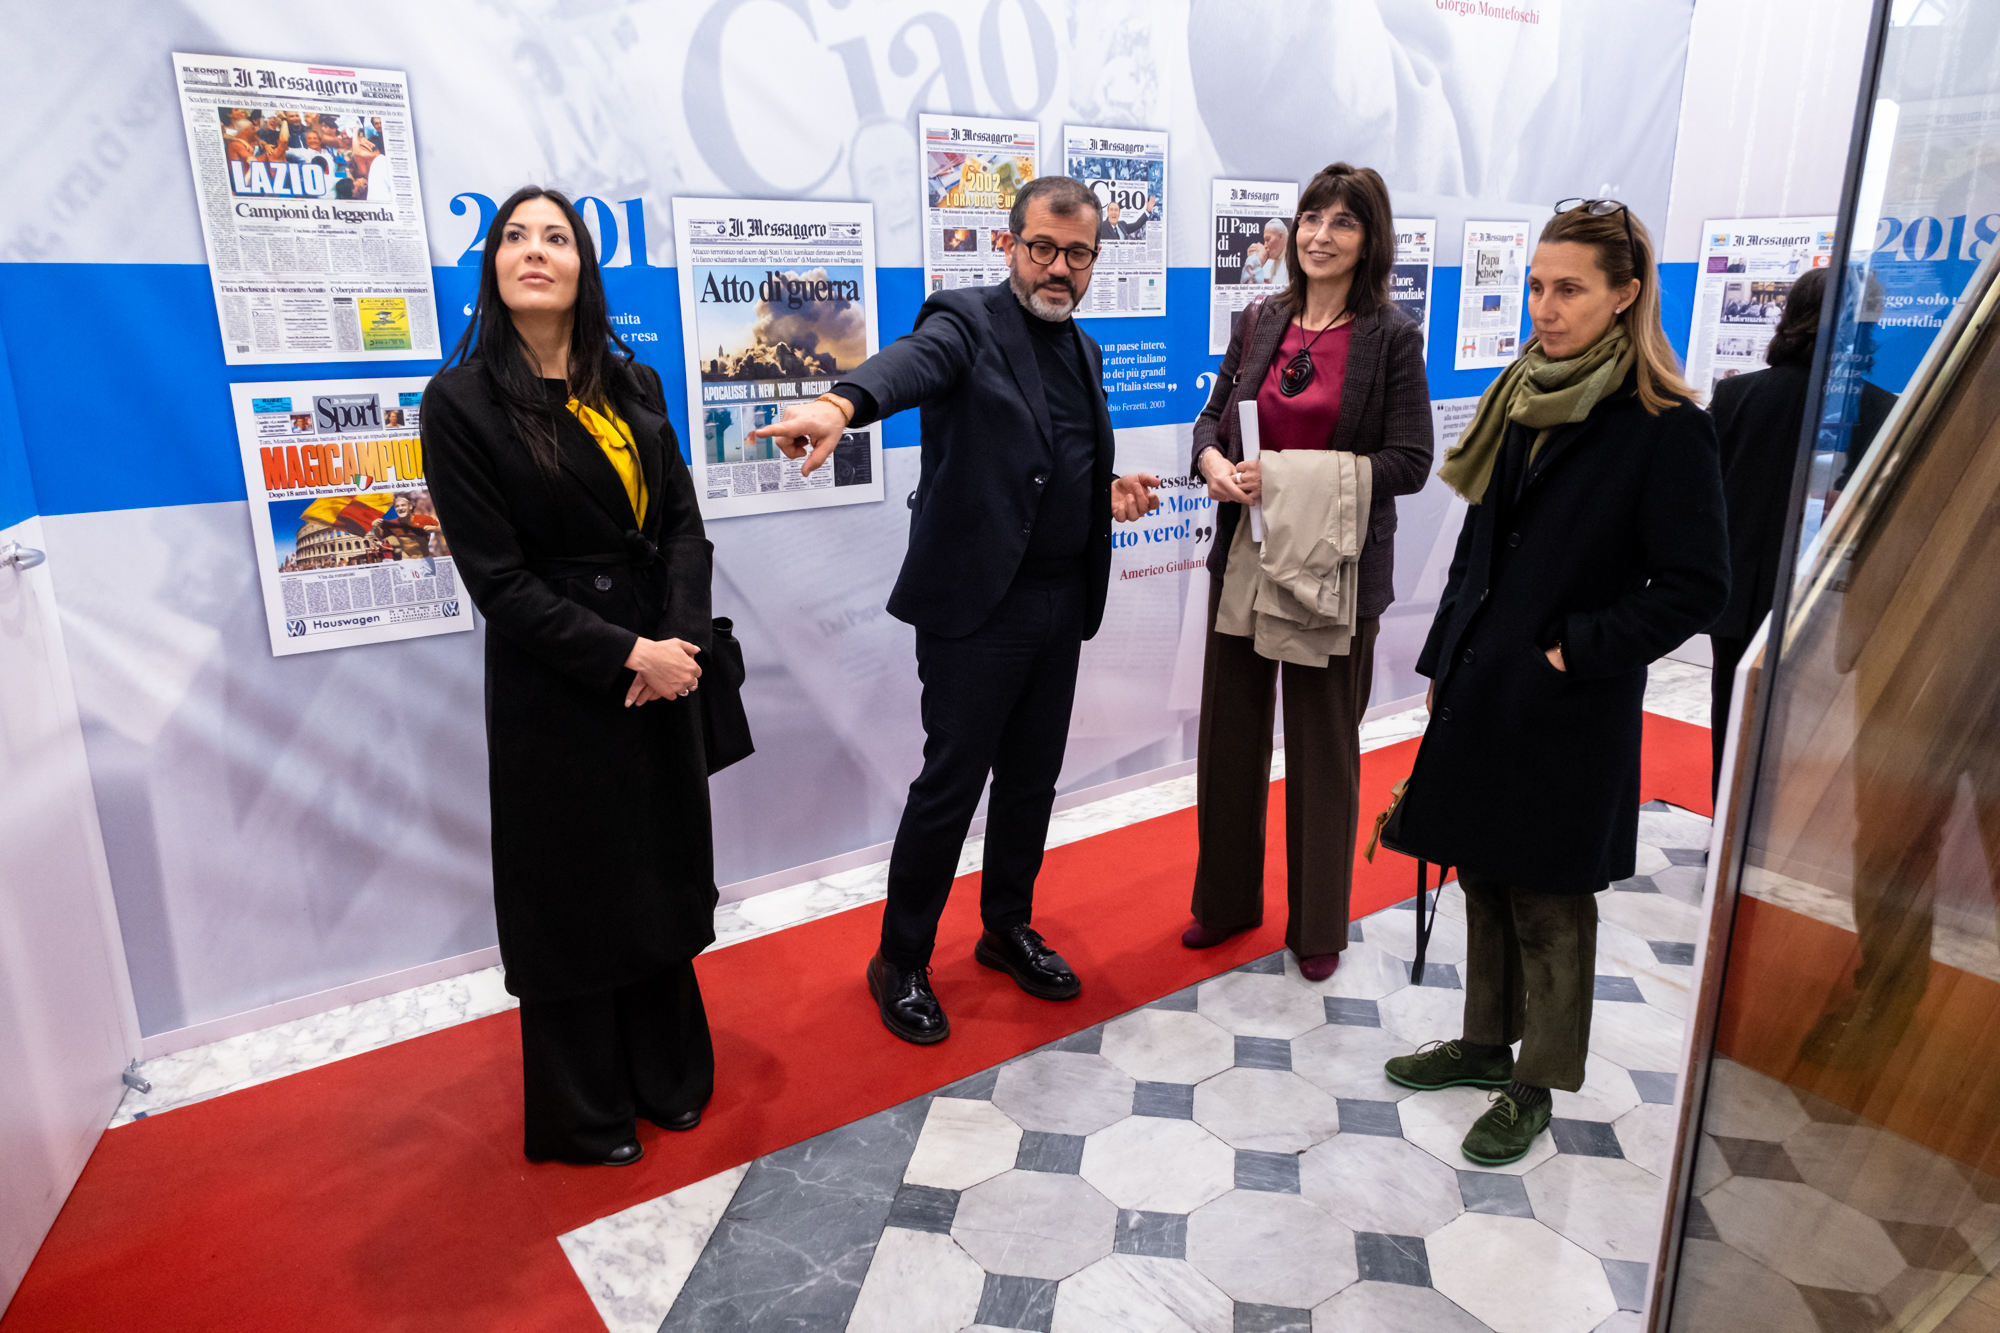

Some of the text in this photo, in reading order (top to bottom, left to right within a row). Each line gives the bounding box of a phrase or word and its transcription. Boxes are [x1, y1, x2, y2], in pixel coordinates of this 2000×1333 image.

[1435, 0, 1540, 24] Giorgio Montefoschi
[233, 68, 253, 88] Il
[256, 70, 358, 96] Messaggero
[682, 0, 1058, 197] Ciao
[950, 128, 1013, 144] Il Messaggero
[1089, 139, 1144, 154] Il Messaggero
[230, 160, 327, 196] LAZIO
[968, 172, 1000, 193] 2002
[946, 193, 971, 207] L'ORA
[1089, 180, 1146, 210] Ciao
[1239, 189, 1280, 202] Messaggero
[235, 203, 394, 224] Campioni da leggenda
[450, 192, 656, 268] 201
[728, 218, 827, 240] Il Messaggero
[1217, 218, 1260, 237] Il Papa
[1217, 235, 1229, 250] di
[1485, 233, 1513, 243] Messaggero
[1732, 235, 1810, 247] Il Messaggero
[1876, 214, 2000, 261] 2018
[1217, 252, 1241, 268] tutti
[1481, 254, 1499, 268] Papa
[1390, 274, 1414, 286] Cuore
[700, 270, 860, 310] Atto di guerra
[1916, 293, 1949, 306] solo
[631, 332, 658, 342] resa
[1104, 341, 1167, 353] un paese intero.
[1111, 357, 1135, 365] attore
[1136, 354, 1166, 364] italiano
[1112, 369, 1125, 378] dei
[1126, 368, 1139, 380] più
[1140, 367, 1166, 379] grandi
[704, 385, 748, 401] APOCALISSE
[751, 385, 756, 398] A
[758, 384, 775, 398] NEW
[777, 382, 799, 398] YORK,
[1116, 381, 1141, 392] l'Italia
[770, 407, 776, 417] 2
[1122, 402, 1149, 411] Ferzetti,
[1150, 400, 1166, 409] 2003
[317, 396, 381, 432] Sport
[334, 486, 357, 495] riscopre
[371, 483, 391, 491] quanto
[1168, 495, 1212, 514] Moro
[1112, 519, 1190, 549] tto vero!
[1120, 565, 1164, 580] Americo
[313, 614, 381, 630] Hauswagen
